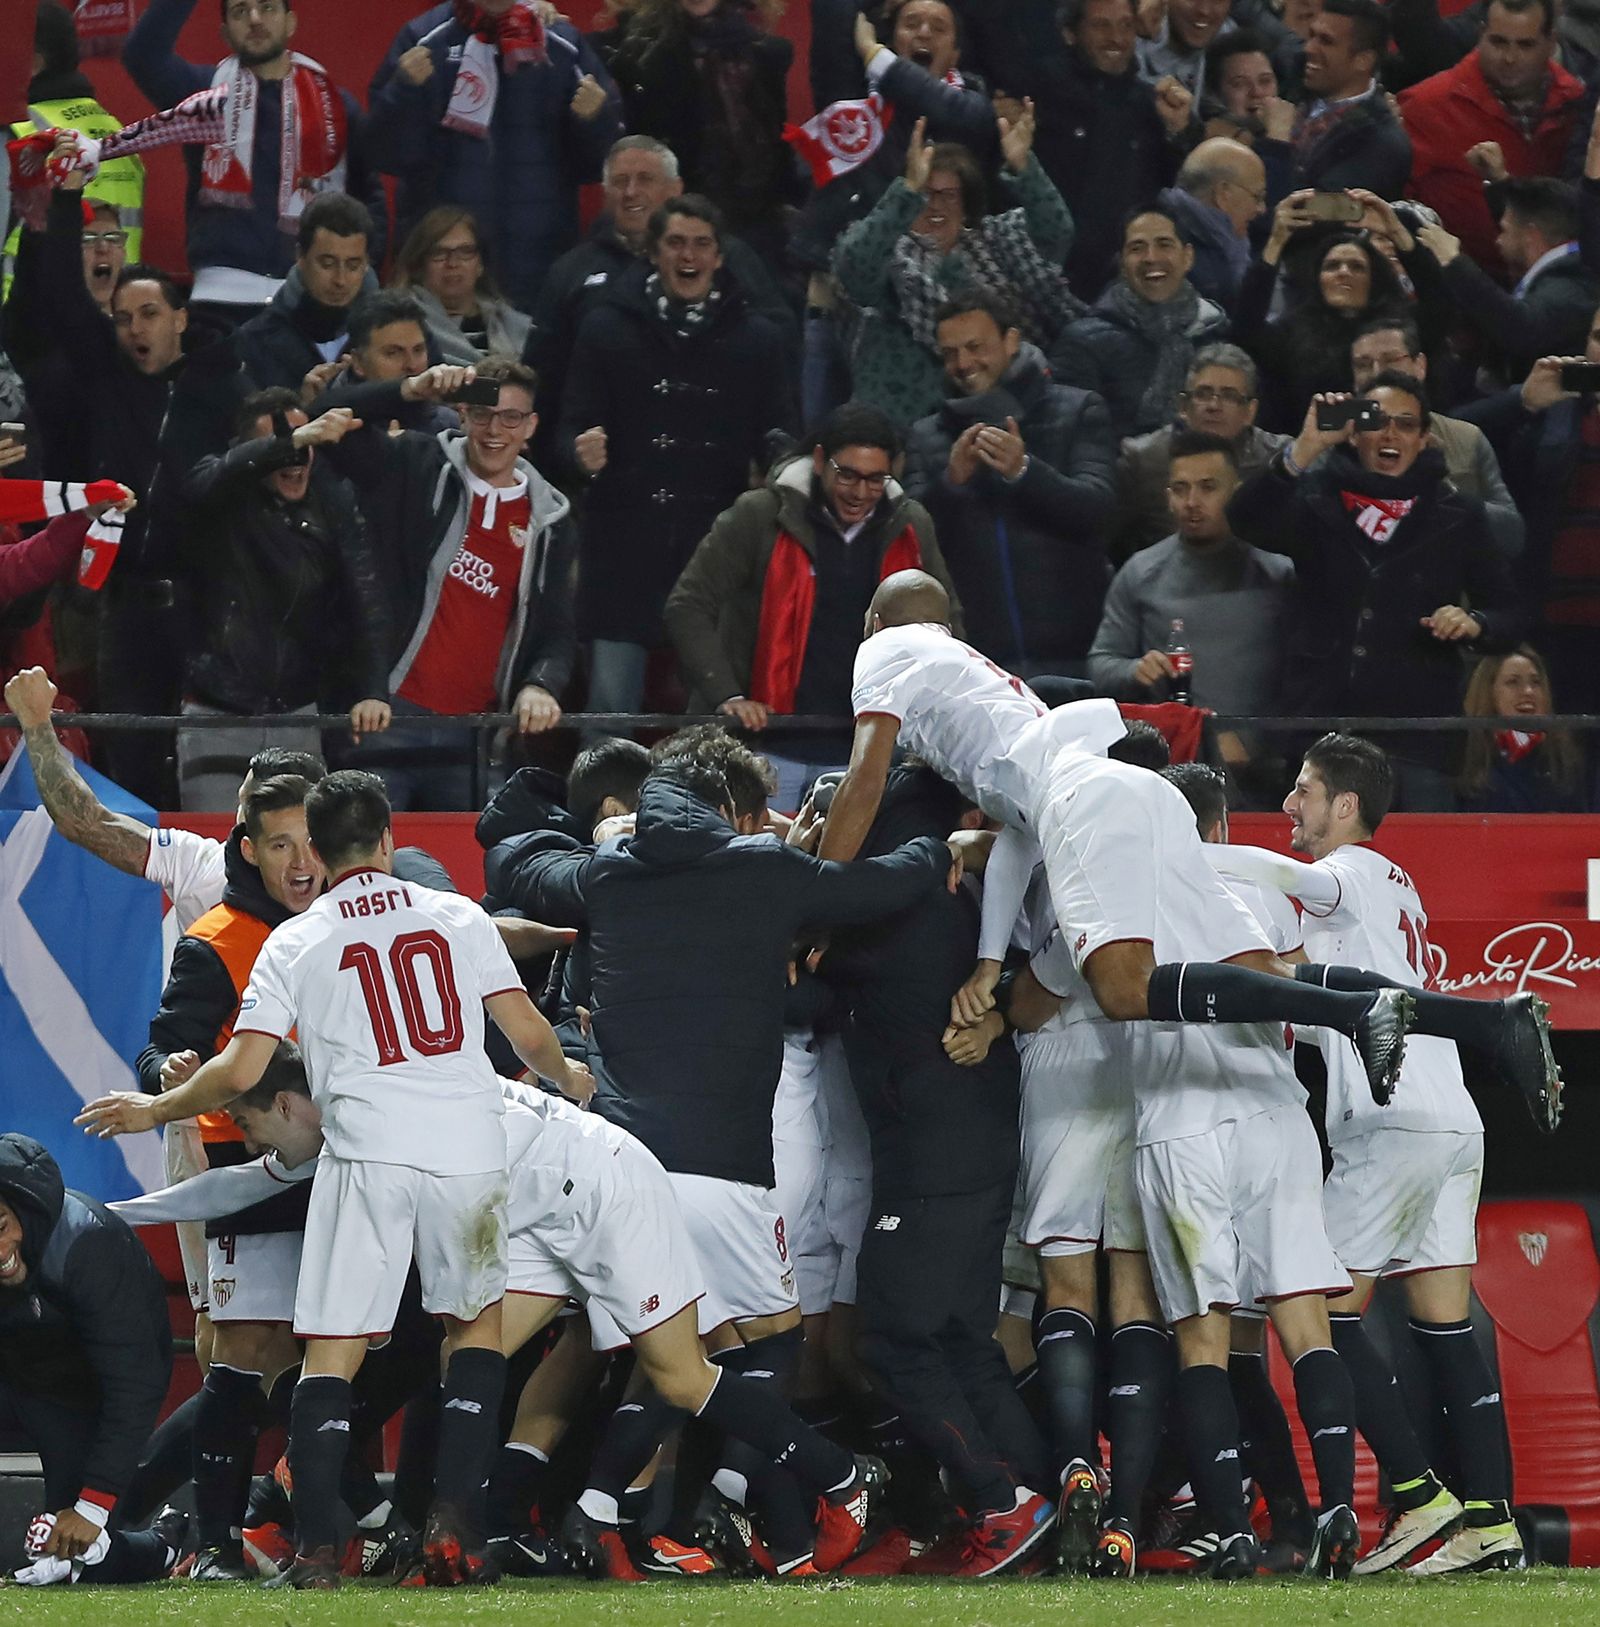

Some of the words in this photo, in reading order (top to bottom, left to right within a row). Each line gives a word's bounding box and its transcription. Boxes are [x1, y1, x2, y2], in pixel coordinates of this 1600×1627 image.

[337, 928, 465, 1067] 10
[774, 1215, 788, 1263] 8
[861, 1490, 869, 1528] adidas
[729, 1512, 752, 1548] adidas
[362, 1541, 387, 1573] adidas
